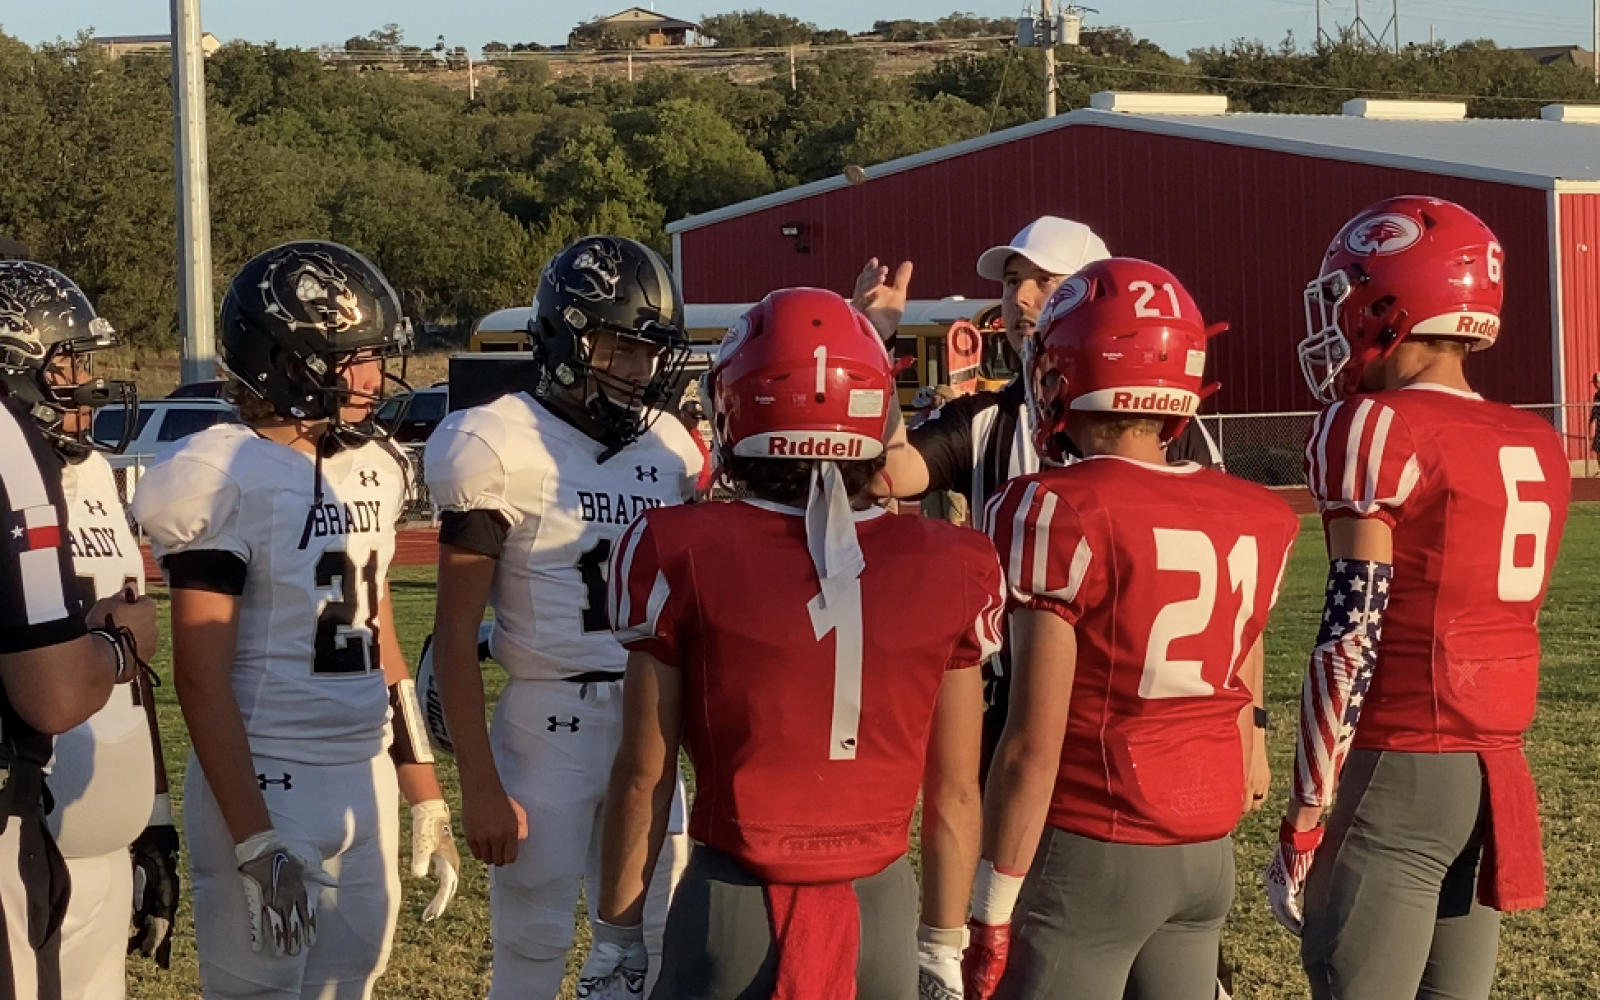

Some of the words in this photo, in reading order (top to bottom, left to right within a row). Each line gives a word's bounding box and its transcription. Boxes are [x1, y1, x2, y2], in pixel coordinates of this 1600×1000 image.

[1487, 240, 1502, 283] 6
[1127, 280, 1181, 318] 21
[813, 345, 828, 393] 1
[1112, 391, 1193, 413] Riddell
[768, 436, 863, 457] Riddell
[314, 501, 381, 537] BRADY
[1498, 445, 1551, 602] 6
[311, 548, 382, 676] 21
[1138, 527, 1259, 699] 21
[806, 568, 863, 761] 1
